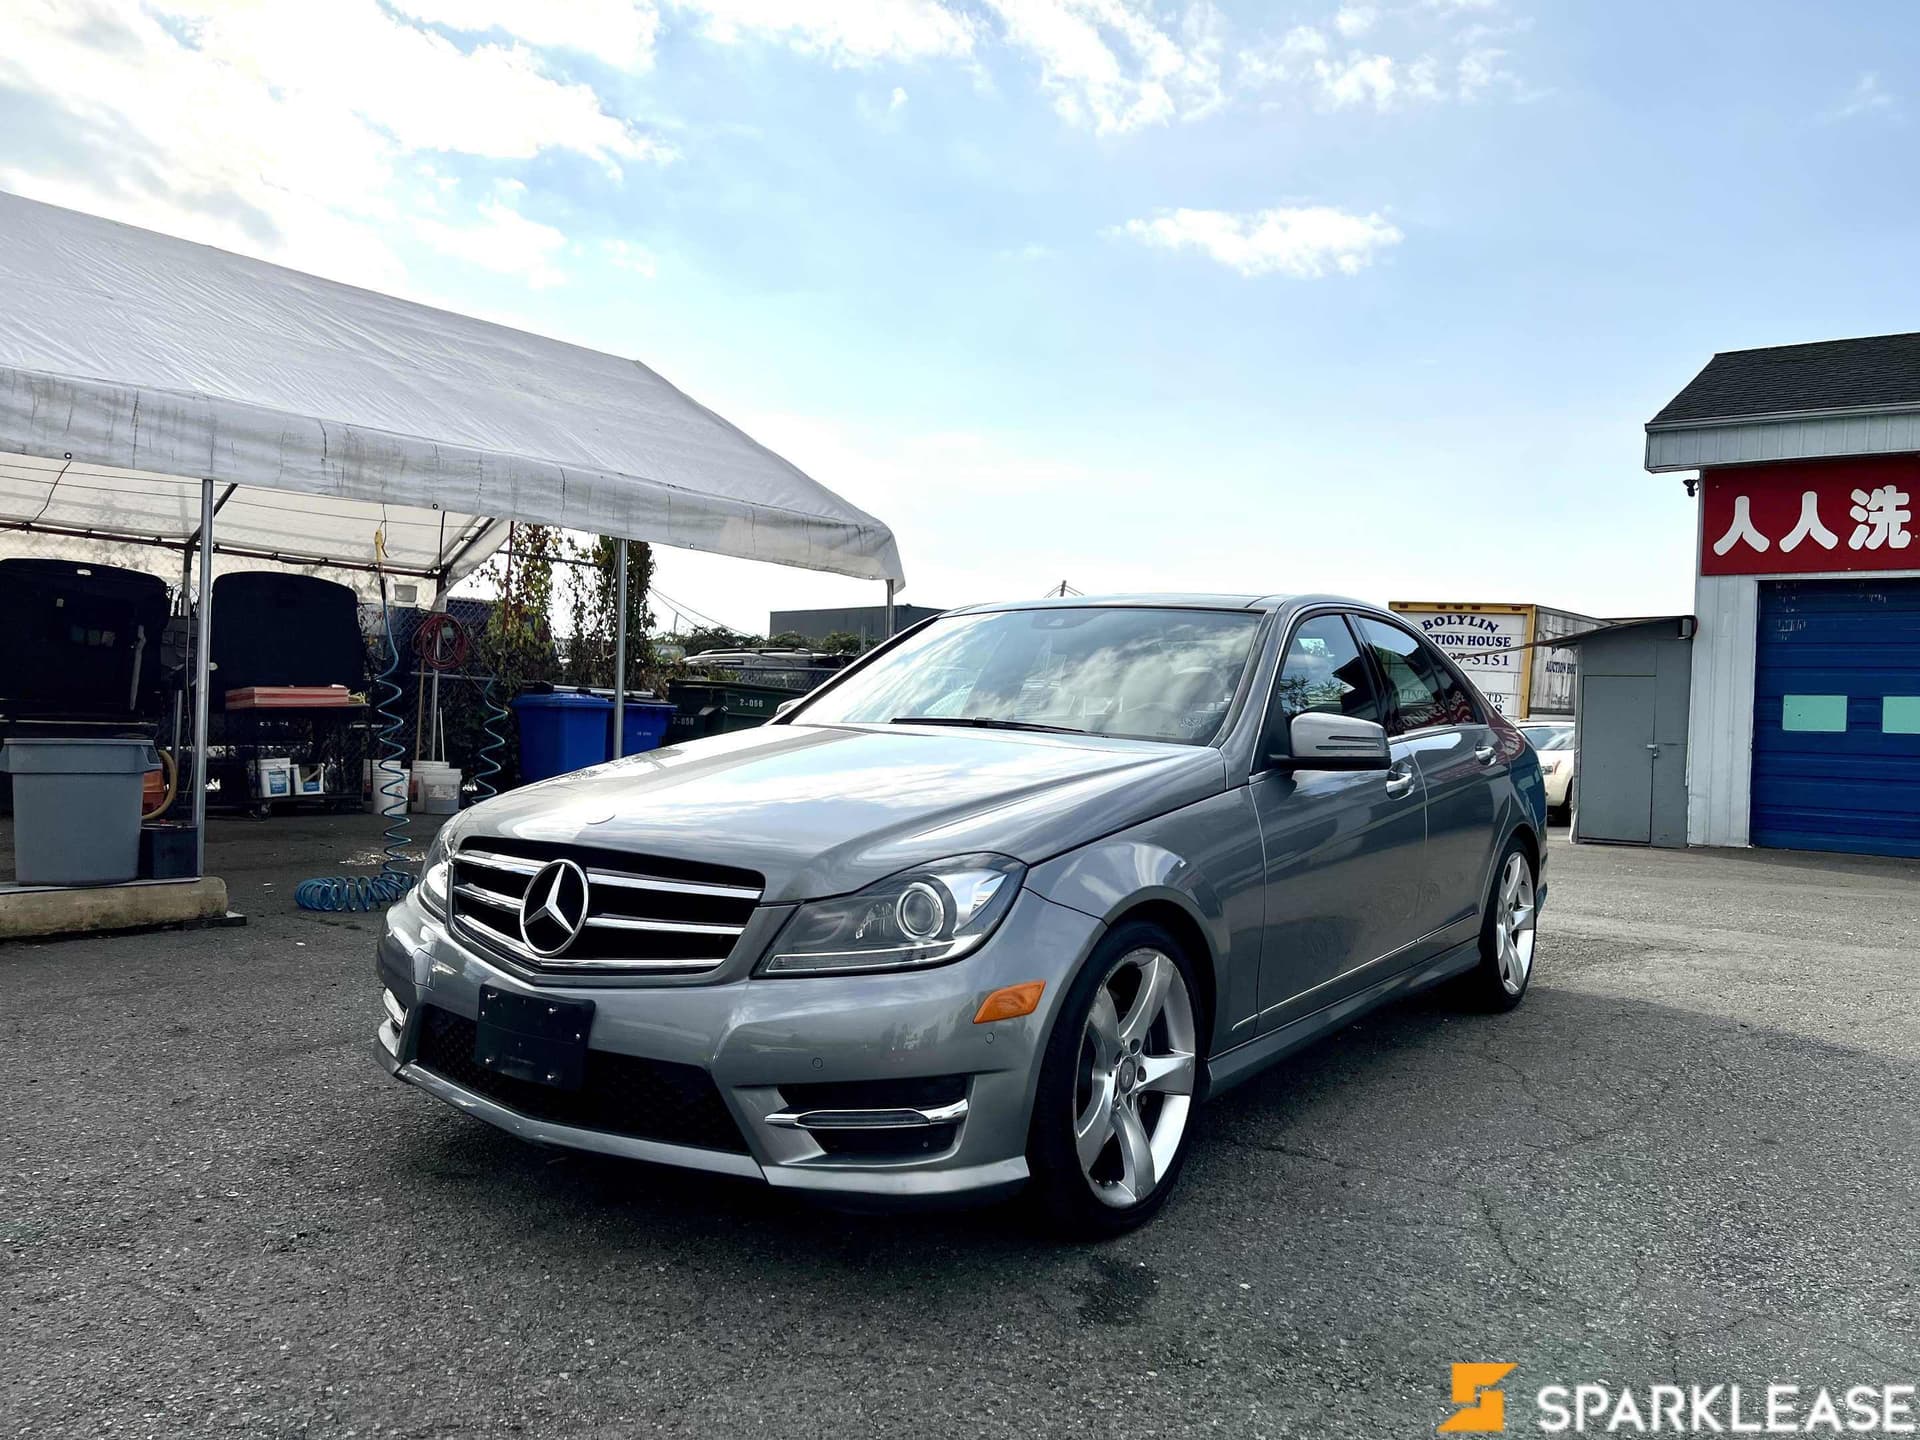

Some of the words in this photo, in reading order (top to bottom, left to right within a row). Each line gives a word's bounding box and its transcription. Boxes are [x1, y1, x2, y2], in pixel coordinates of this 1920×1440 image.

[1713, 485, 1911, 556] 人人洗
[1421, 614, 1499, 634] BOLYLIN
[1467, 635, 1511, 647] HOUSE
